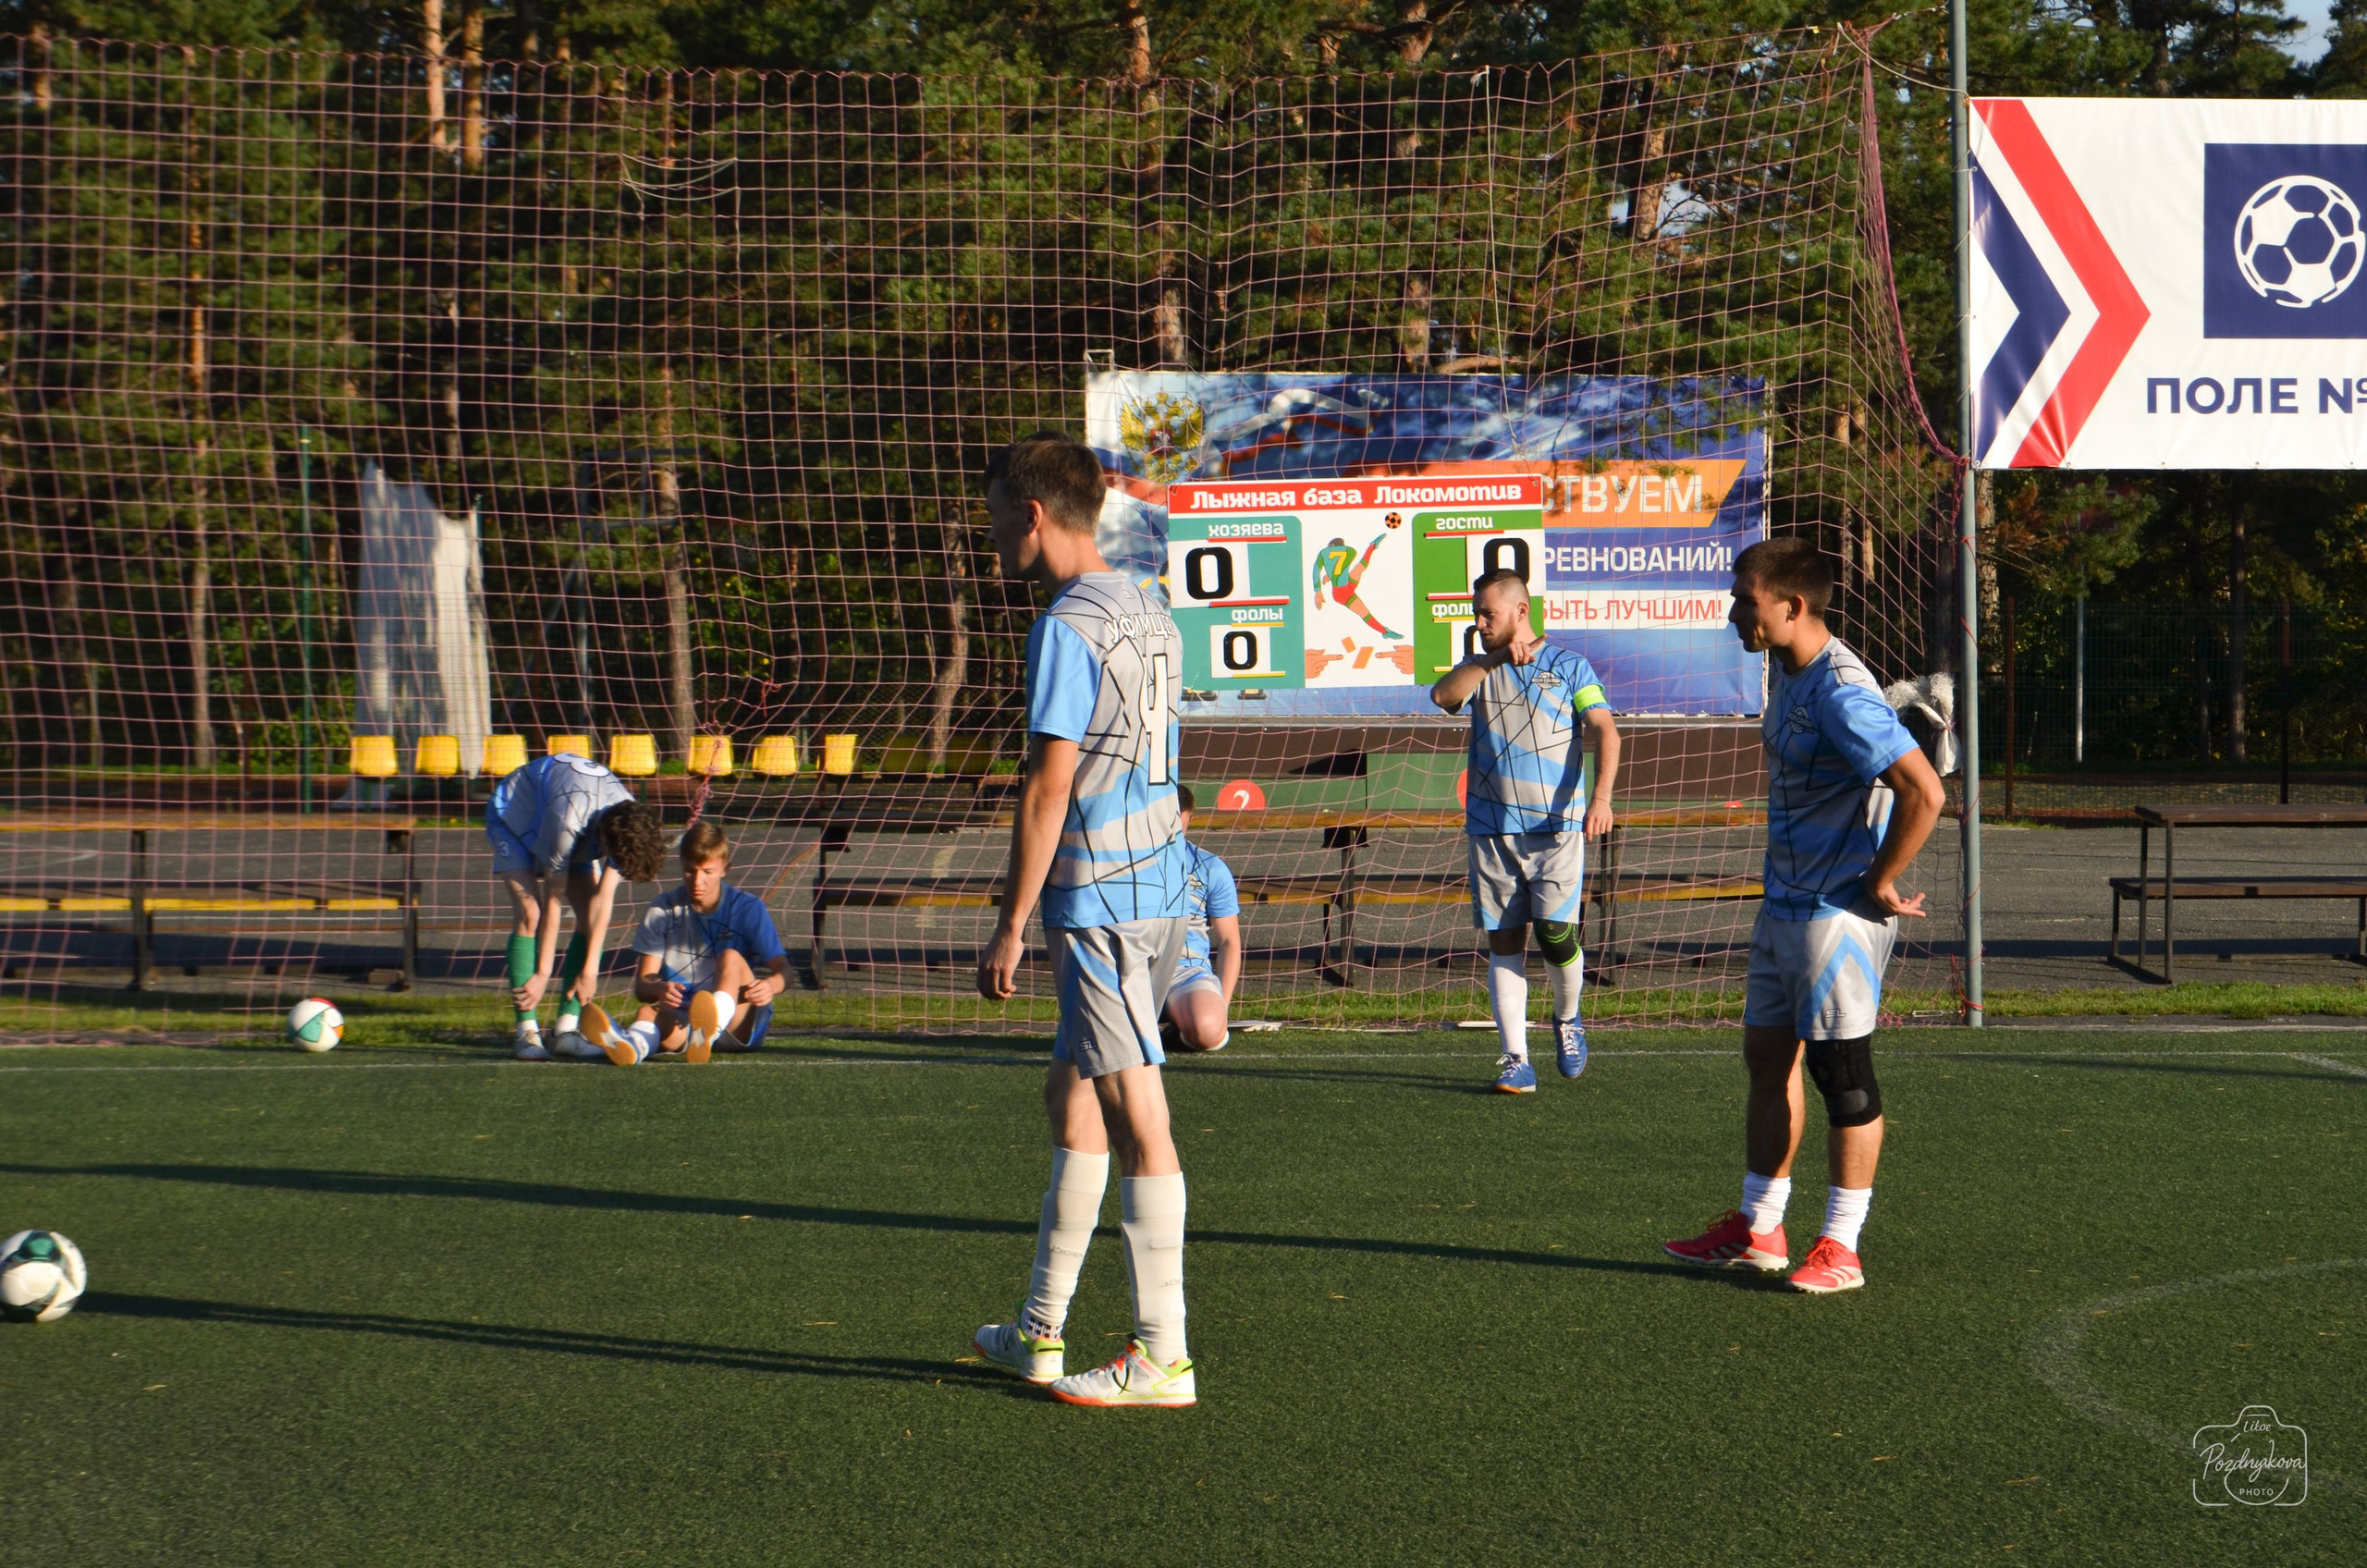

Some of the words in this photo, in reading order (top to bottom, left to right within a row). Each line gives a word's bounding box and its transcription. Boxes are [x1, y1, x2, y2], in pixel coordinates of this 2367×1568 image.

[2147, 377, 2299, 414] ПОЛЕ
[1190, 490, 1296, 509] Лыжная
[1303, 488, 1362, 506] база
[1374, 484, 1522, 504] Локомотив
[1208, 522, 1284, 537] хозяева
[1436, 516, 1493, 531] гости
[1184, 546, 1234, 600] 0
[1329, 551, 1347, 575] 7
[1232, 608, 1283, 624] фолы
[1605, 599, 1723, 620] ЛУЧШИМ!
[1223, 631, 1258, 670] 0
